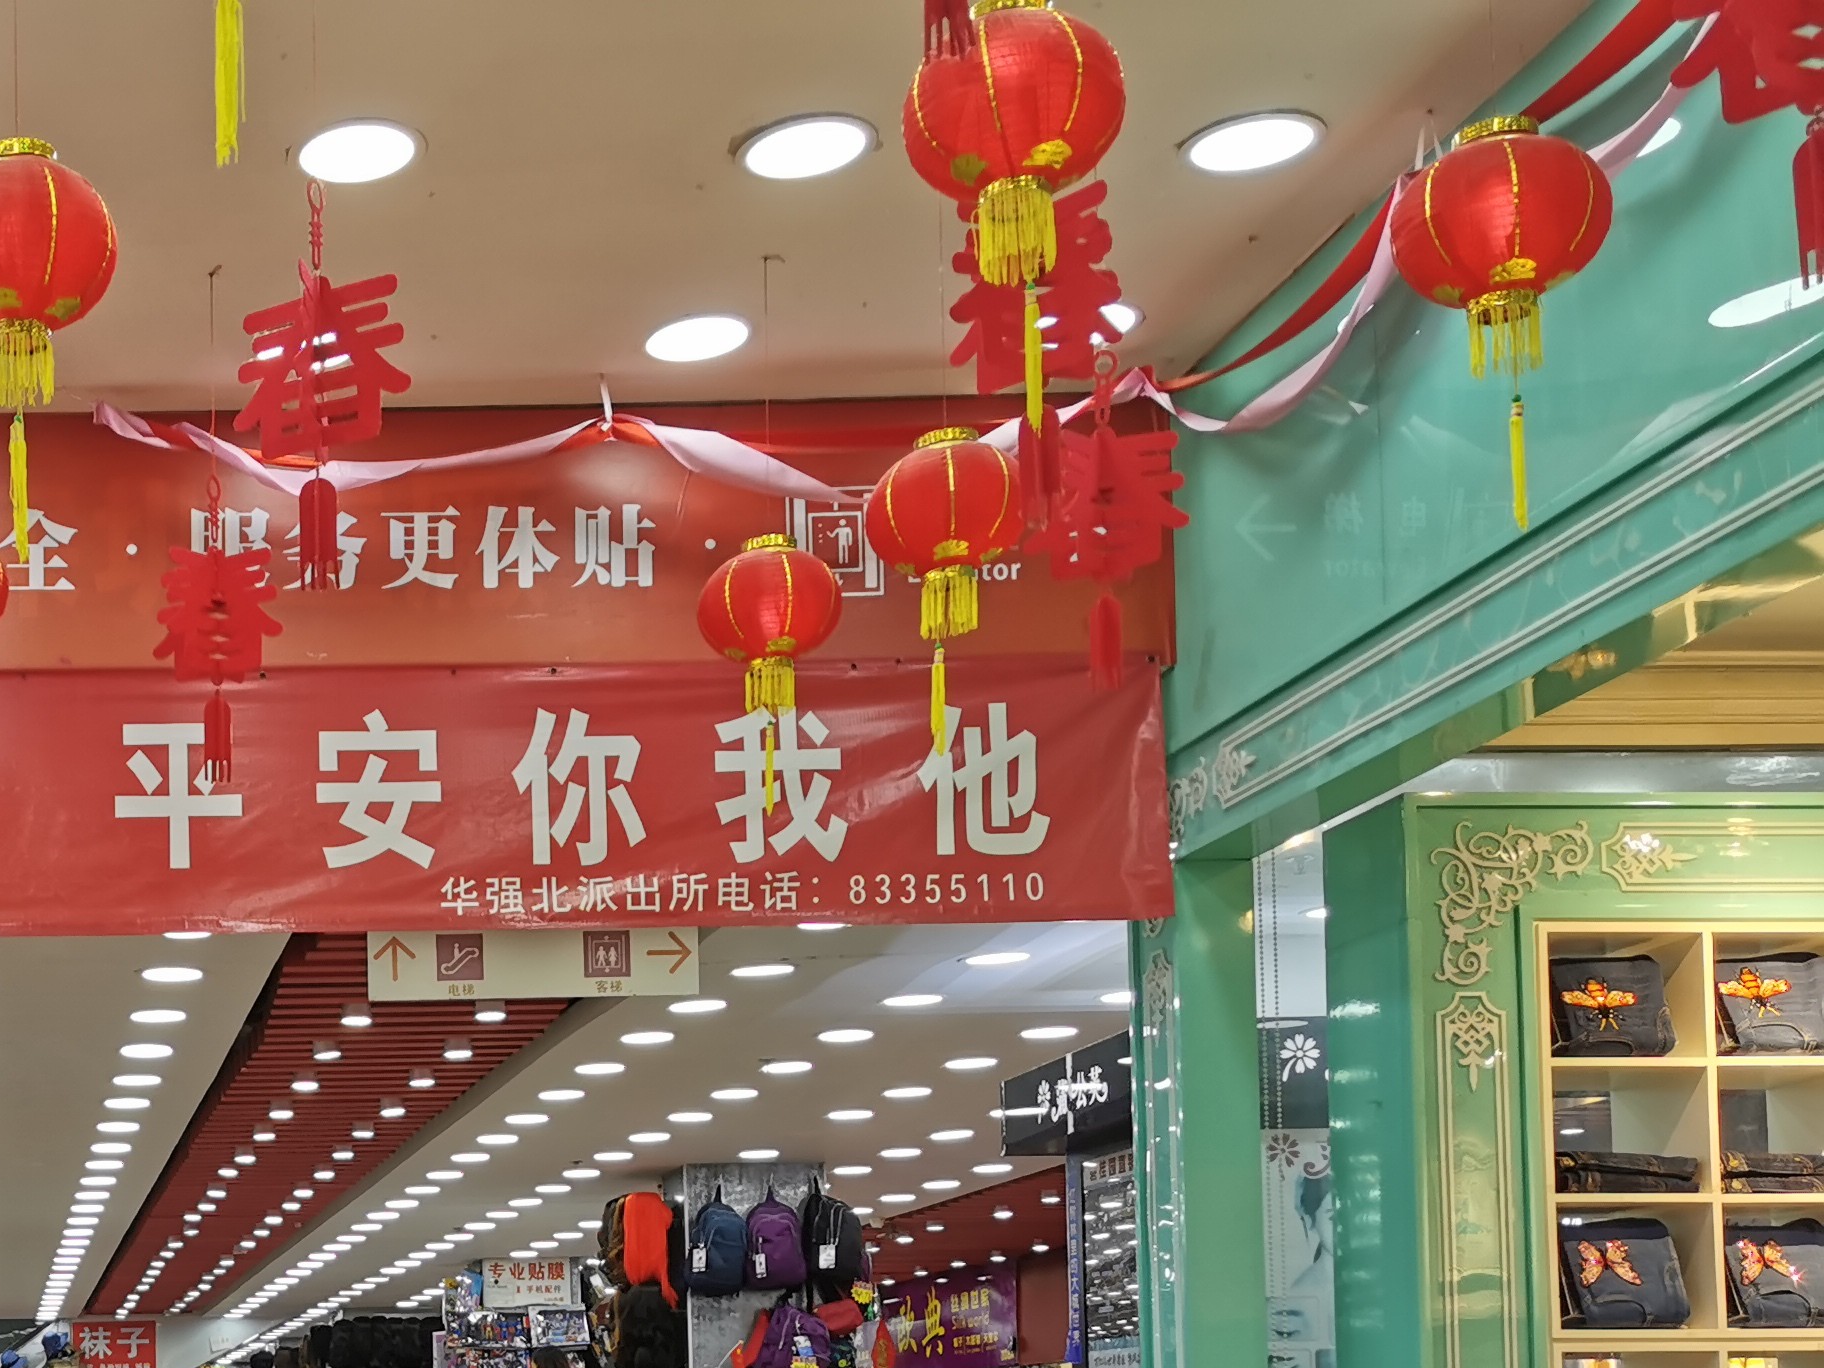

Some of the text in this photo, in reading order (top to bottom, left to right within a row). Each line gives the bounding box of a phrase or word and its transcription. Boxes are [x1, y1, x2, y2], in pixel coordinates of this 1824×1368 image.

[190, 504, 657, 591] 服务更体贴
[448, 980, 623, 997] 电梯 客梯
[487, 1261, 566, 1281] 专业贴膜
[78, 1325, 150, 1360] 袜子
